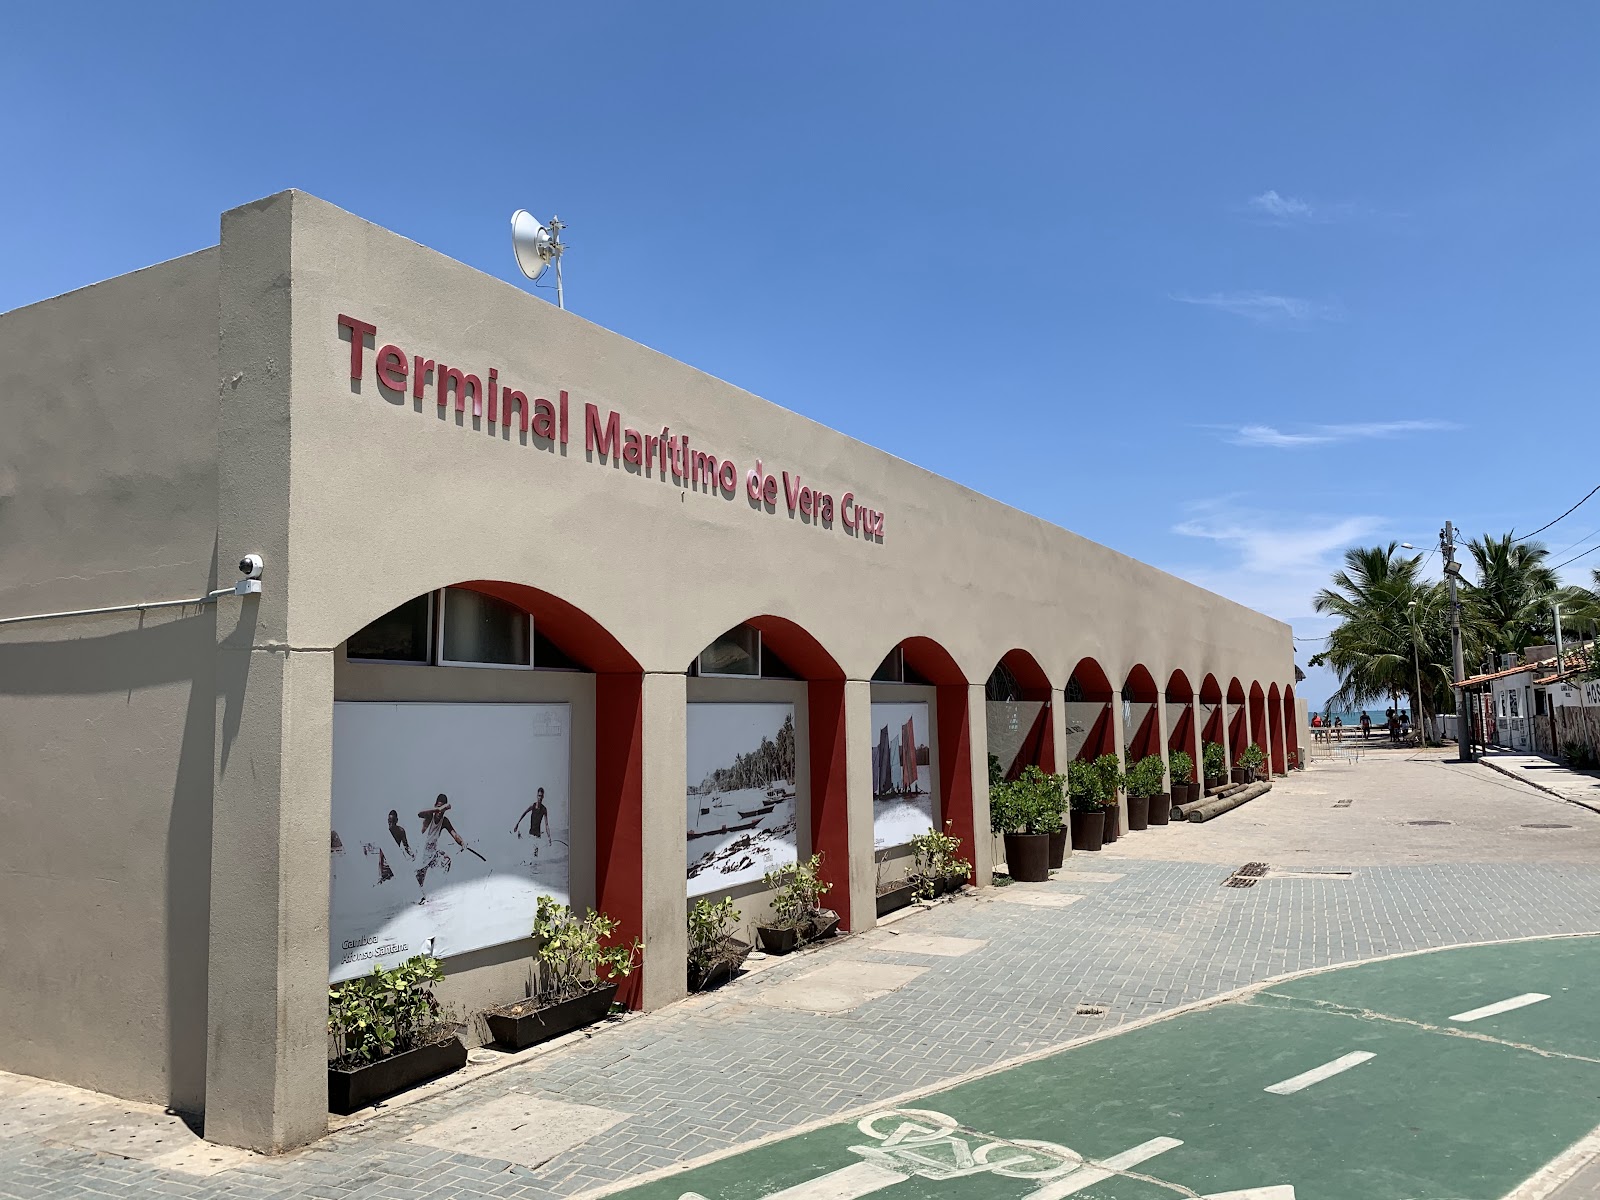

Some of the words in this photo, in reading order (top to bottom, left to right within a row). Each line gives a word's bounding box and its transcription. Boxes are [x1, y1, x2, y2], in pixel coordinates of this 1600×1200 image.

[338, 313, 568, 444] Terminal
[585, 402, 738, 492] Marítimo
[746, 459, 778, 506] de
[782, 471, 834, 523] Vera
[841, 492, 885, 537] Cruz
[341, 935, 379, 949] Gamboa
[341, 951, 373, 964] Afonso
[374, 943, 409, 957] Santana
